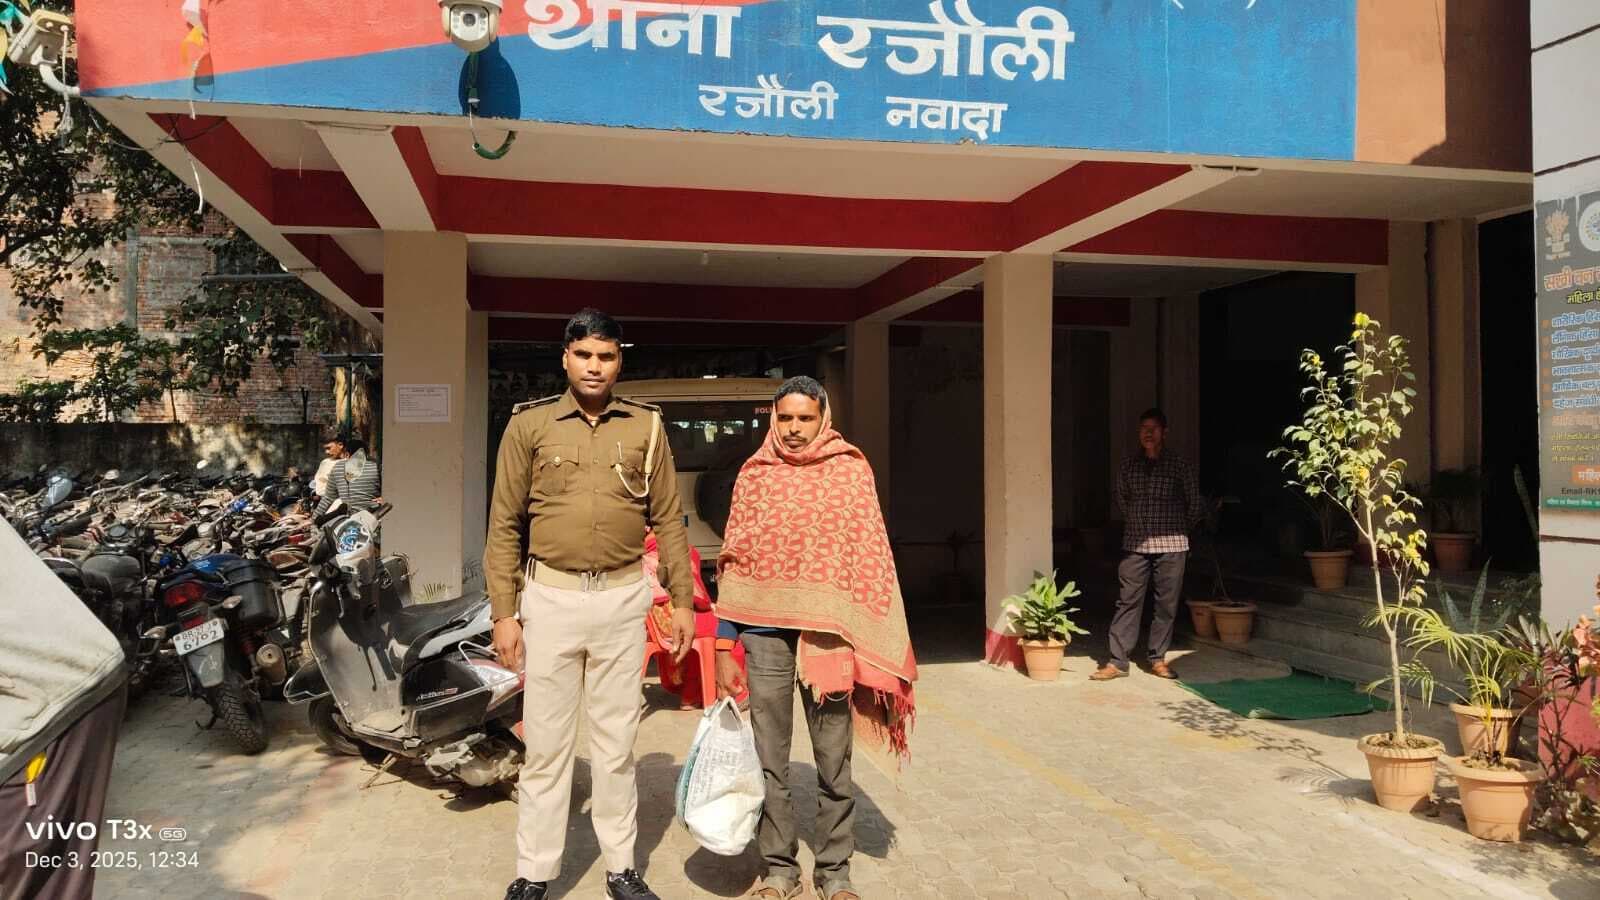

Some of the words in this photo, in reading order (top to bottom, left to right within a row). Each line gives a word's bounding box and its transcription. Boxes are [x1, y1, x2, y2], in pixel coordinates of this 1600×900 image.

[523, 0, 742, 58] थाना
[817, 0, 1075, 82] रजौली
[698, 74, 839, 120] रजौली
[886, 95, 1008, 140] नवादा
